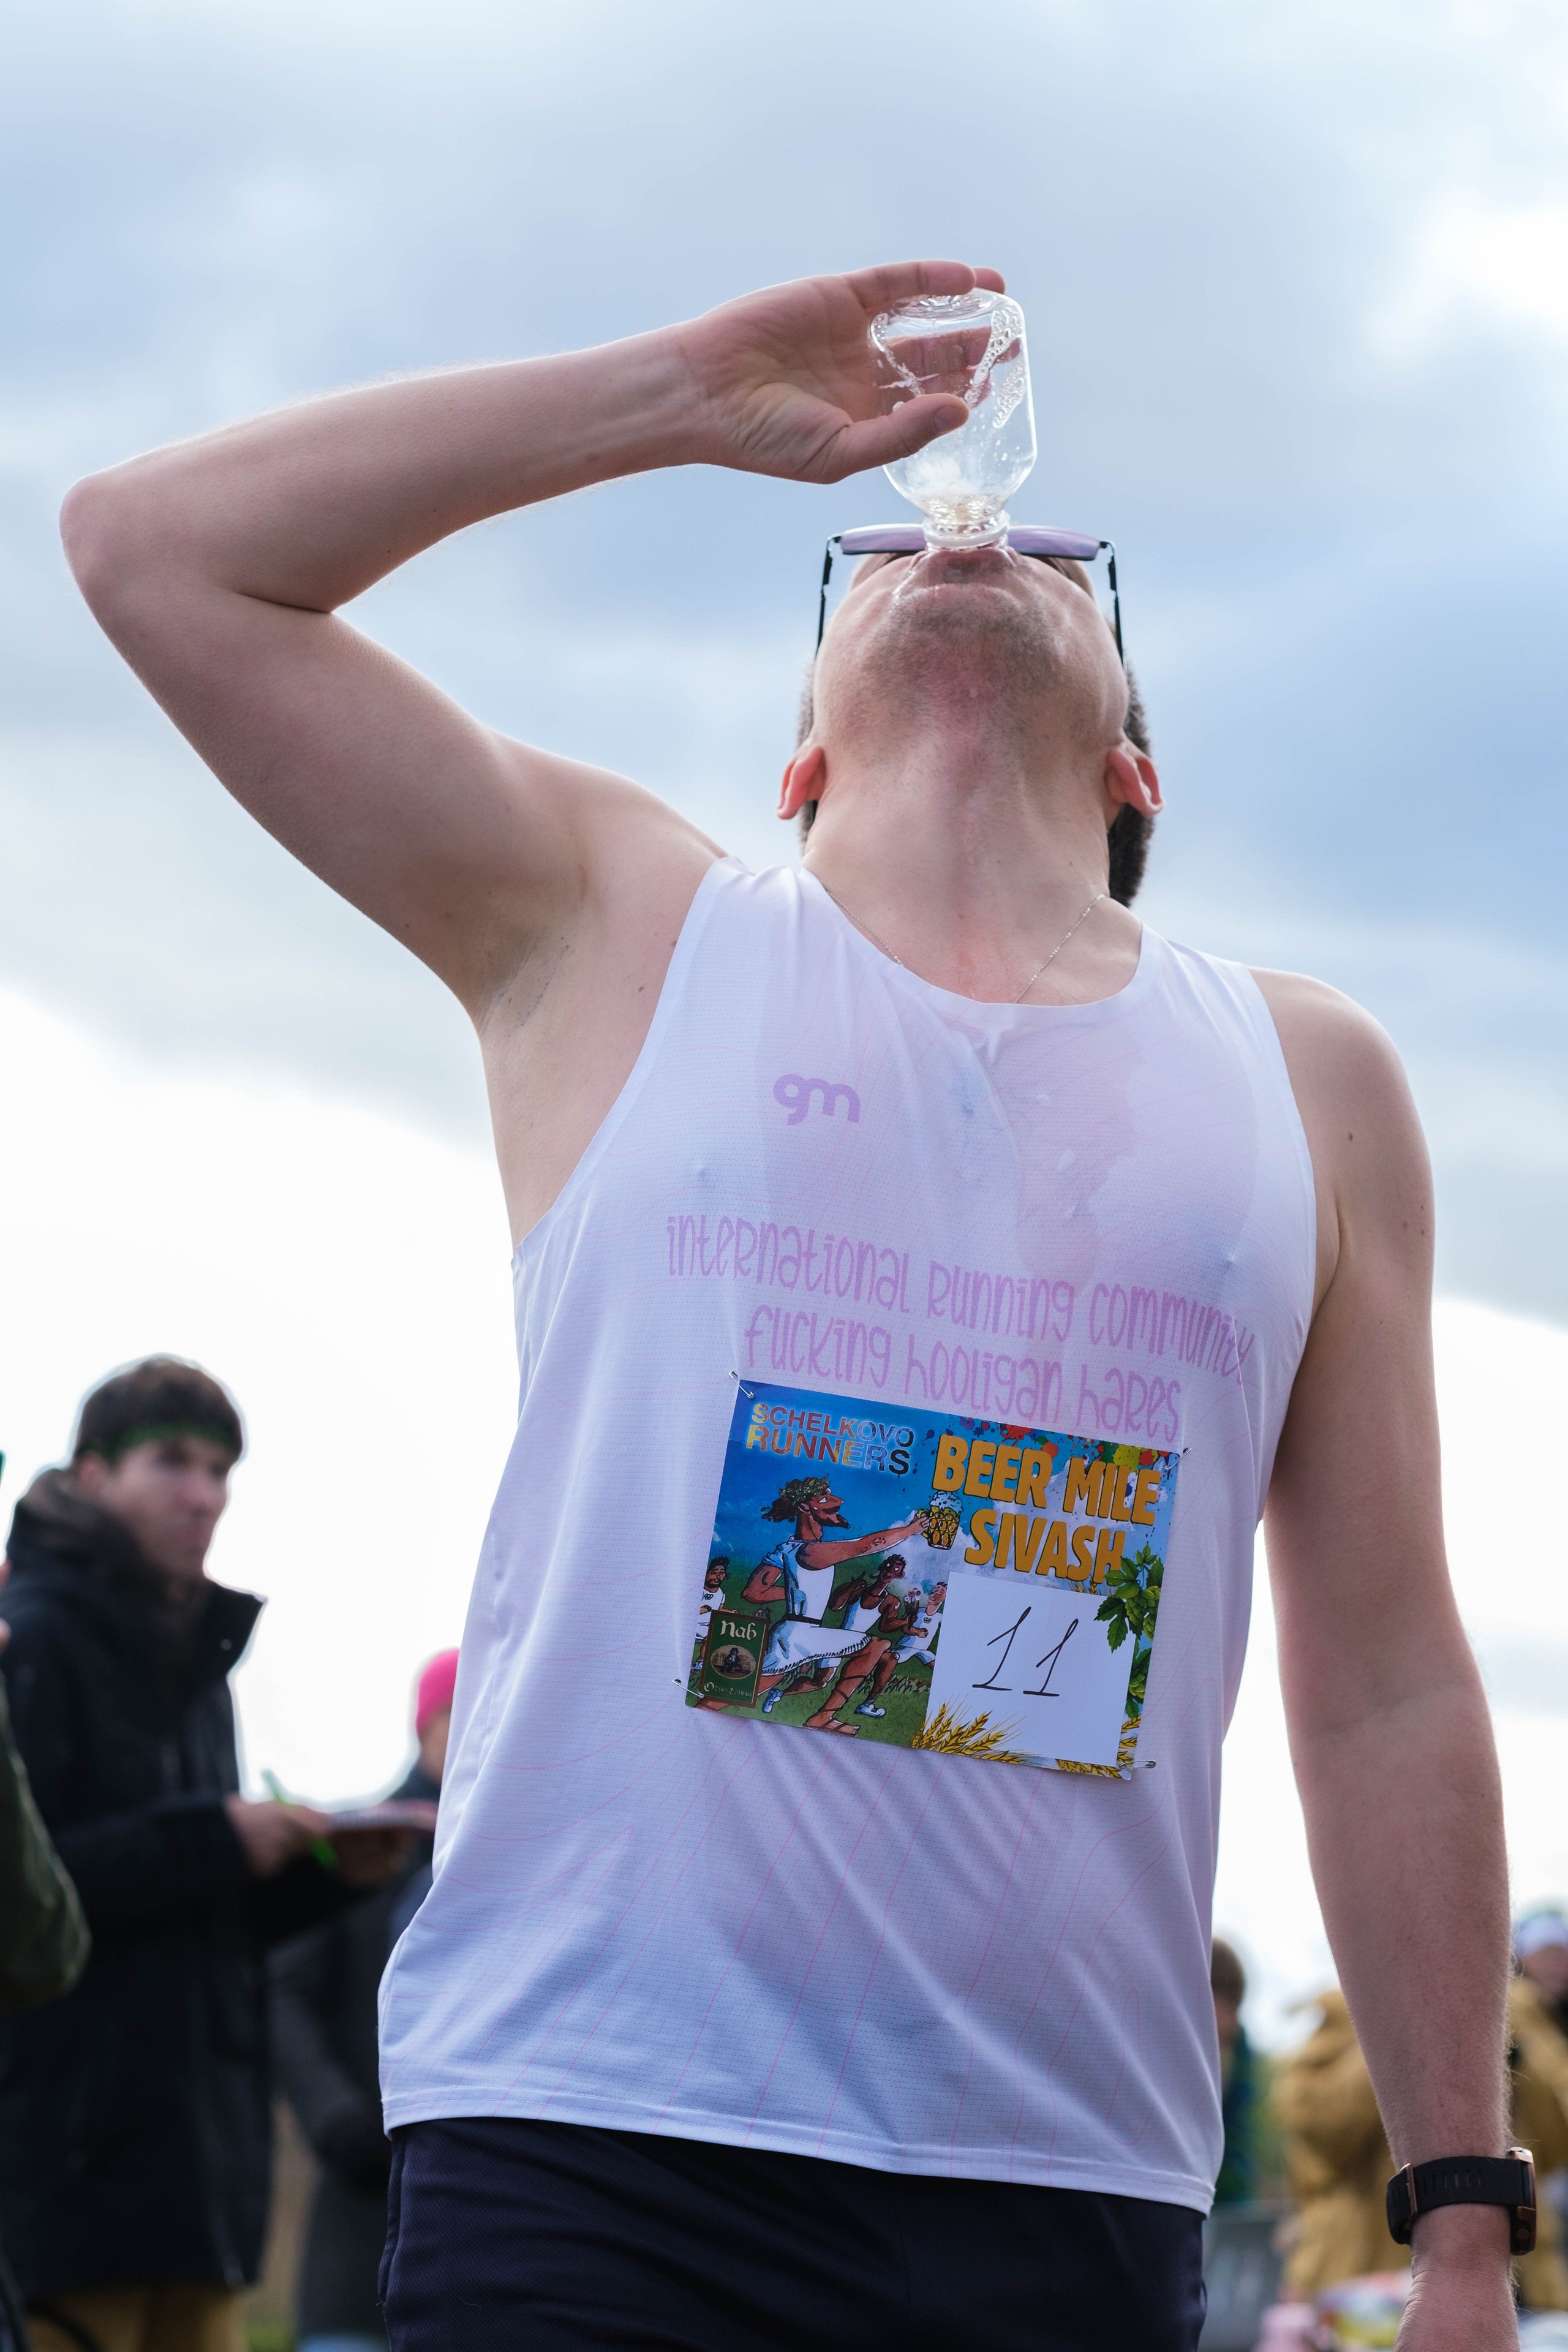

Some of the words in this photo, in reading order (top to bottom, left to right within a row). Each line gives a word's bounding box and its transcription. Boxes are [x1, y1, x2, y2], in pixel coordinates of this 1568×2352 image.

[744, 1303, 891, 1389] fucking
[905, 1333, 1063, 1424] hooligan
[745, 1424, 910, 1475] RUNNERS
[751, 1403, 914, 1447] SCHELKOVO
[931, 1434, 1053, 1509] BEER
[1062, 1457, 1161, 1526] MILE
[963, 1508, 1126, 1585] SIVASH
[971, 1606, 1079, 1697] 11
